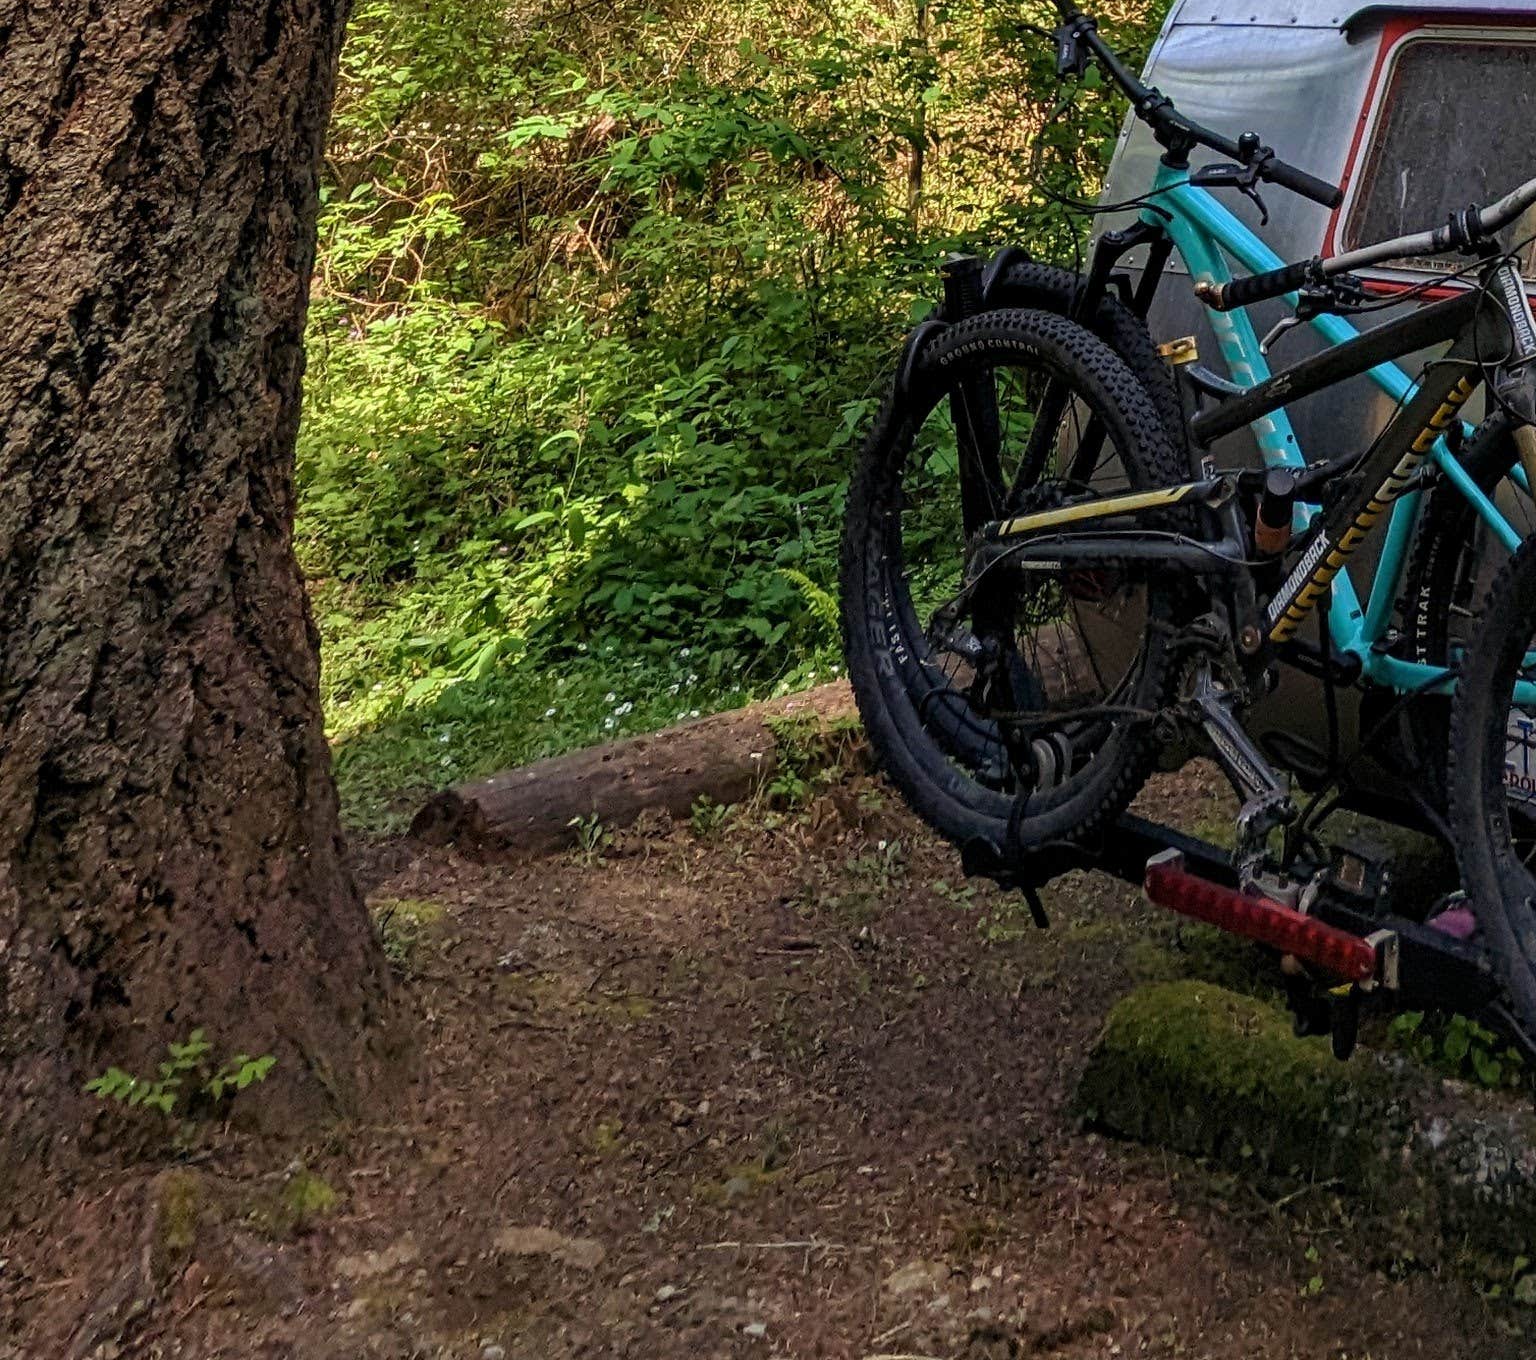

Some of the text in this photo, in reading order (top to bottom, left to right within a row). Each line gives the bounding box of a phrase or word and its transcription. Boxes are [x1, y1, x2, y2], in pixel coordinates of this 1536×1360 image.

[1498, 266, 1536, 355] DIAMONDBACK
[940, 339, 985, 366] GROUND
[1266, 529, 1332, 622] DIAMONDBACK
[1416, 585, 1431, 639] TRAK
